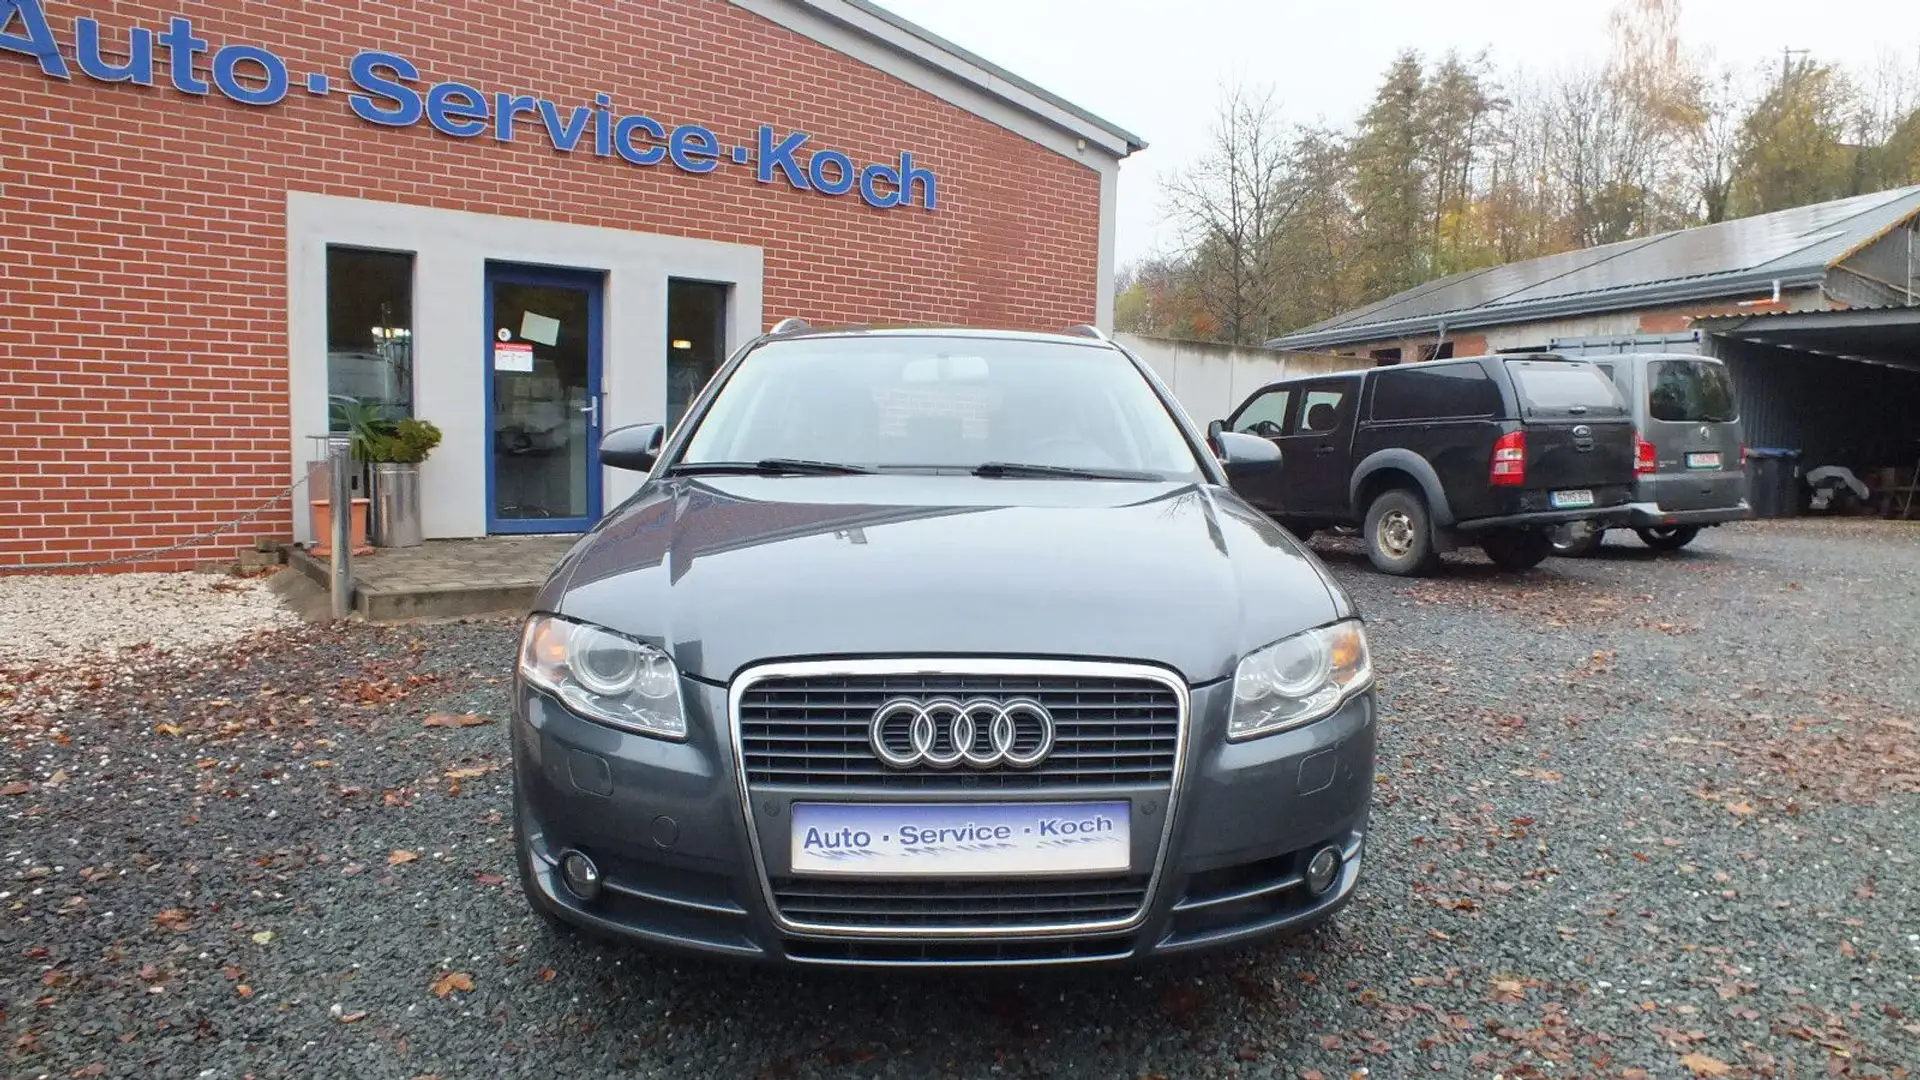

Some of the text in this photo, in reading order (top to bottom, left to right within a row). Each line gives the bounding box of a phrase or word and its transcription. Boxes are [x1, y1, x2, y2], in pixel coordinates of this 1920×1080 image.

[0, 0, 937, 210] Auto Service Koch
[803, 816, 1113, 849] Auto Service Koch
